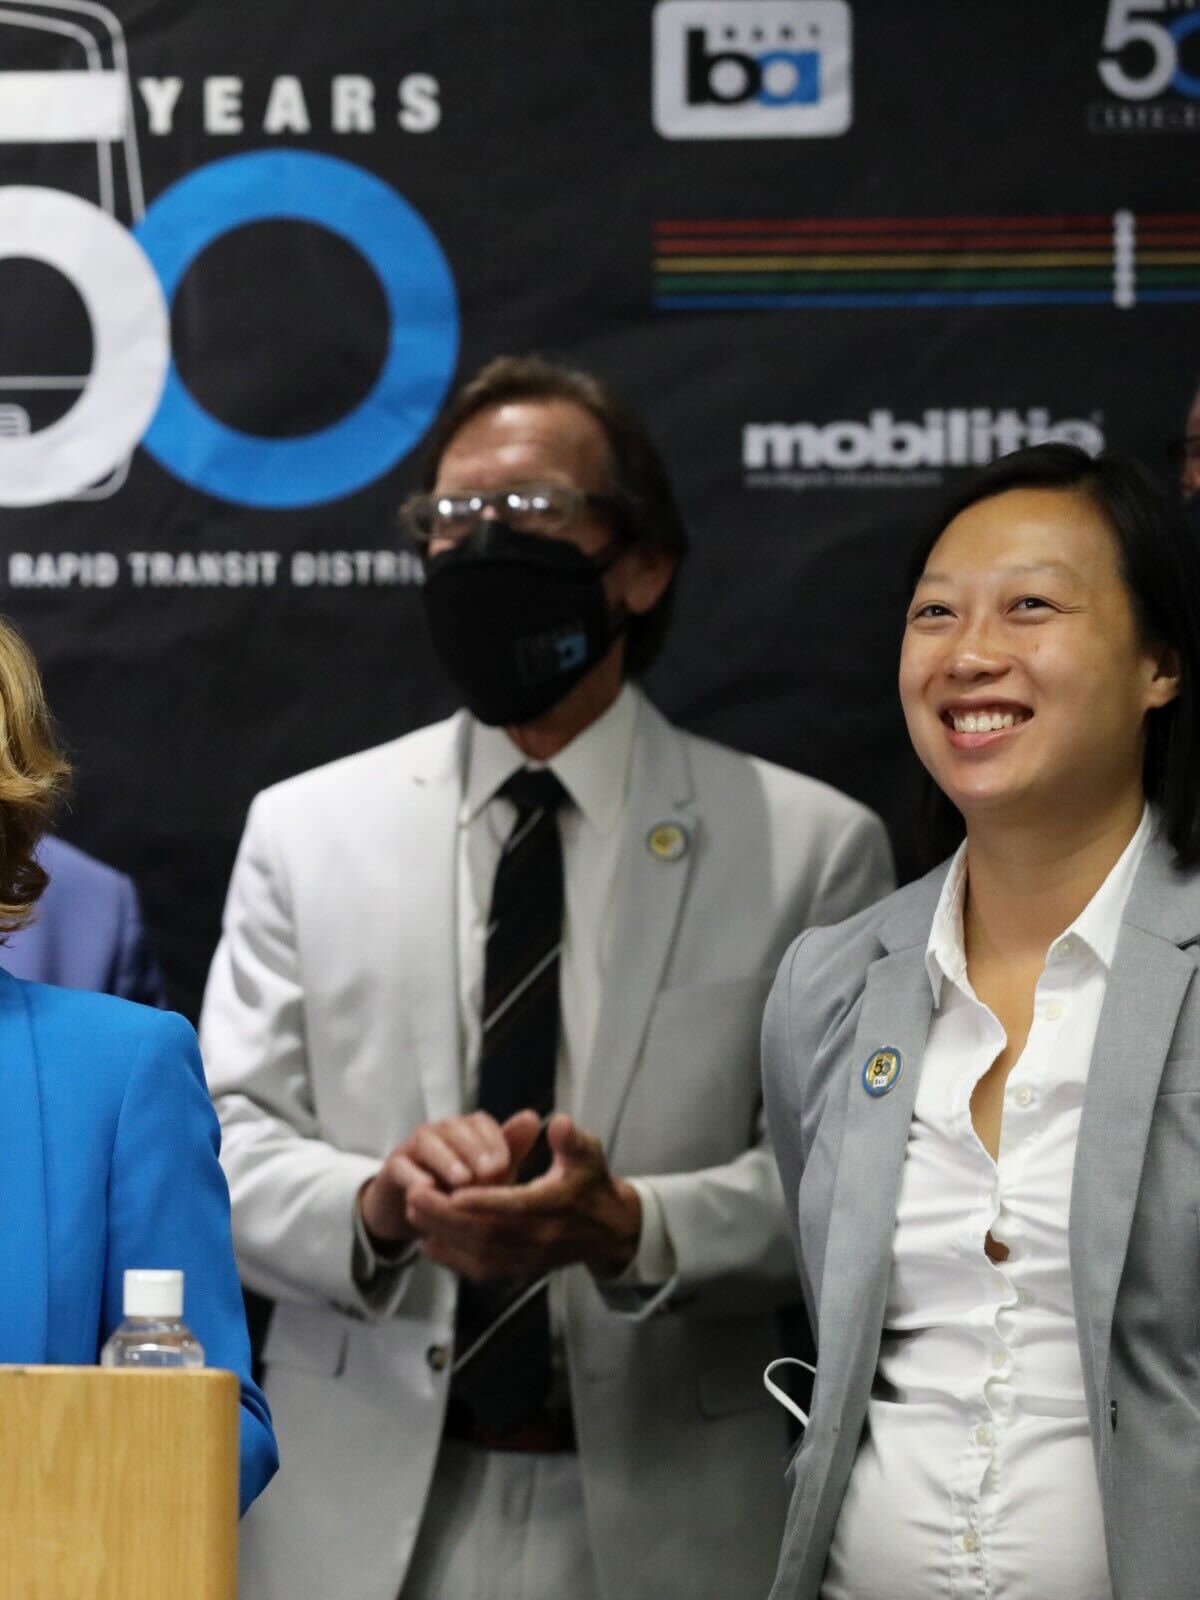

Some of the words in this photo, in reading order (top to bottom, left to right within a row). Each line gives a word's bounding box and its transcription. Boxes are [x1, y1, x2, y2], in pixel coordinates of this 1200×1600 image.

[138, 73, 441, 135] YEARS
[8, 552, 120, 588] RAPID
[127, 552, 281, 588] TRANSIT
